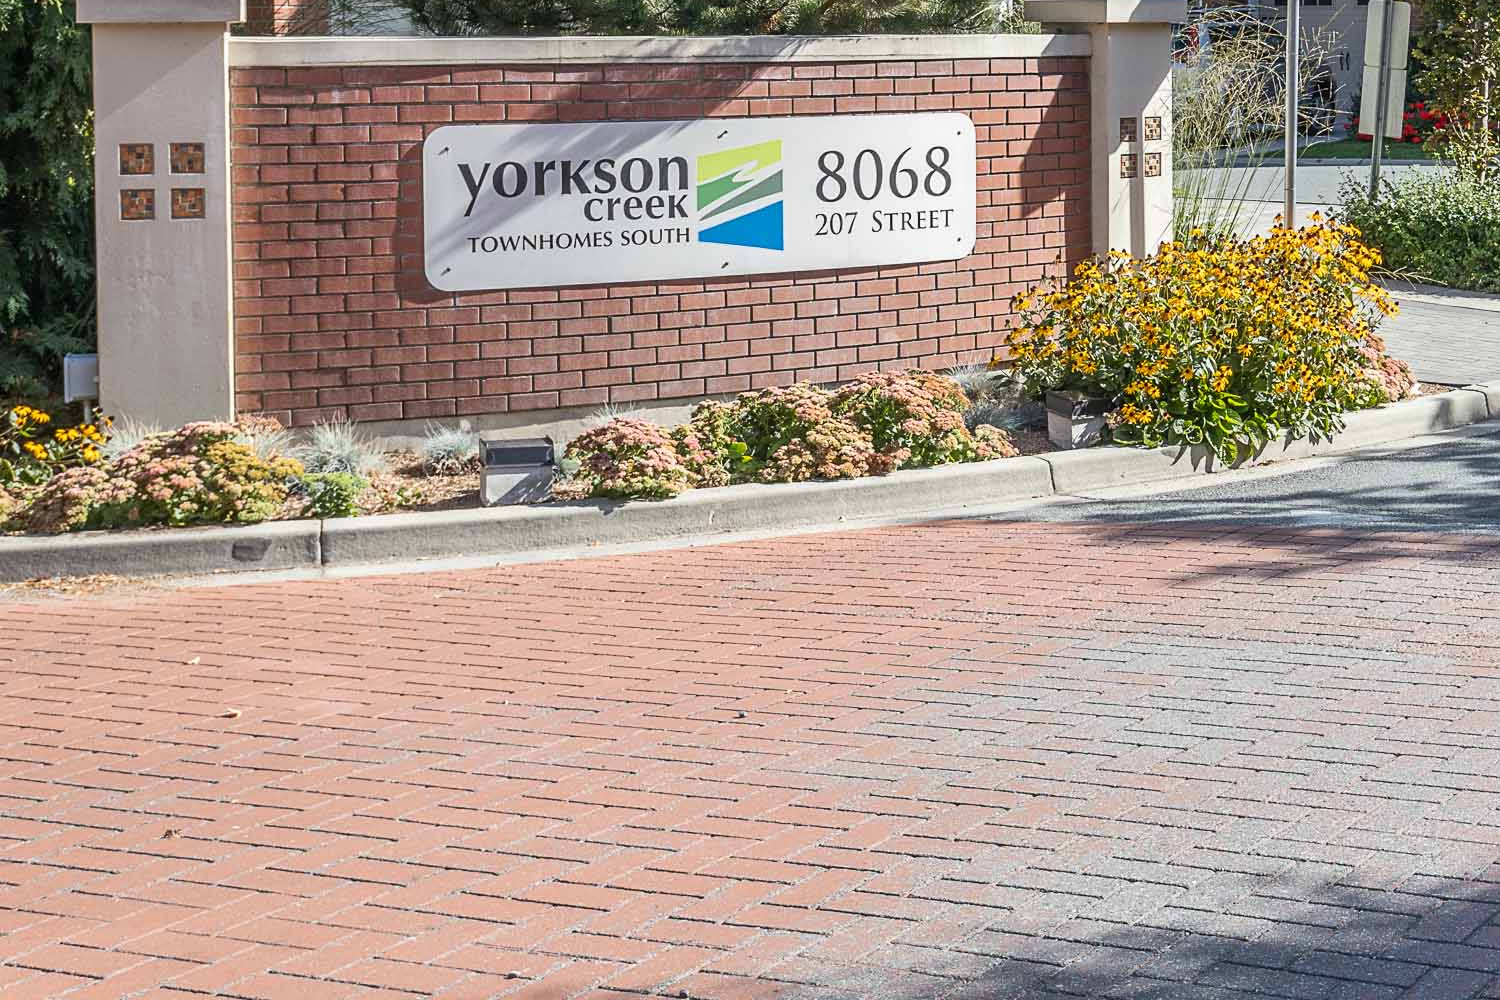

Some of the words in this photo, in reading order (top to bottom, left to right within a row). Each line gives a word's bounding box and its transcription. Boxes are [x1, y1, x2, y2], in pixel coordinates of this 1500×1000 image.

[457, 156, 689, 218] yorkson
[815, 146, 953, 203] 8068
[583, 194, 689, 222] creek
[815, 210, 858, 236] 207
[871, 208, 954, 233] STREET
[467, 230, 613, 254] TOWNHOMES
[620, 227, 690, 247] SOUTH
